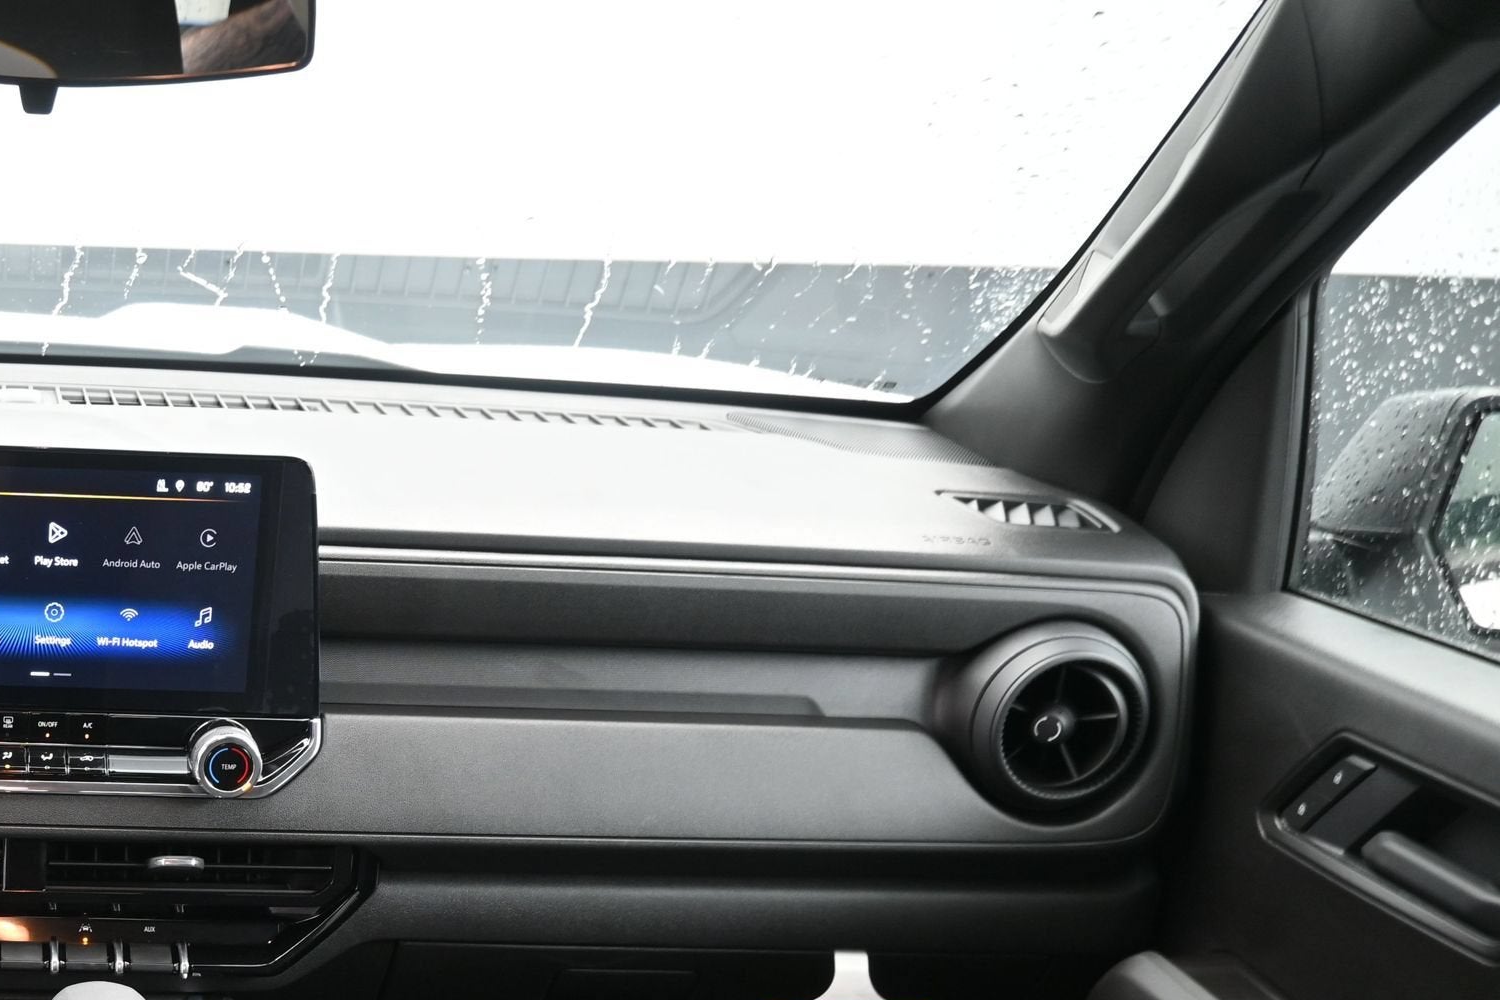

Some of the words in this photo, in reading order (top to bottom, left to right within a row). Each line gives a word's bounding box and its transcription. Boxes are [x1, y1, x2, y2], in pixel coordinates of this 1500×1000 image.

[34, 555, 53, 568] Play
[54, 556, 78, 567] Store
[102, 558, 138, 569] Android
[139, 560, 161, 569] Auto
[176, 561, 202, 572] Apple
[204, 561, 238, 572] CarPlay
[34, 634, 72, 648] Settings
[97, 636, 121, 647] Wi-Fi
[121, 638, 158, 650] Hotspot
[188, 639, 214, 650] Audio
